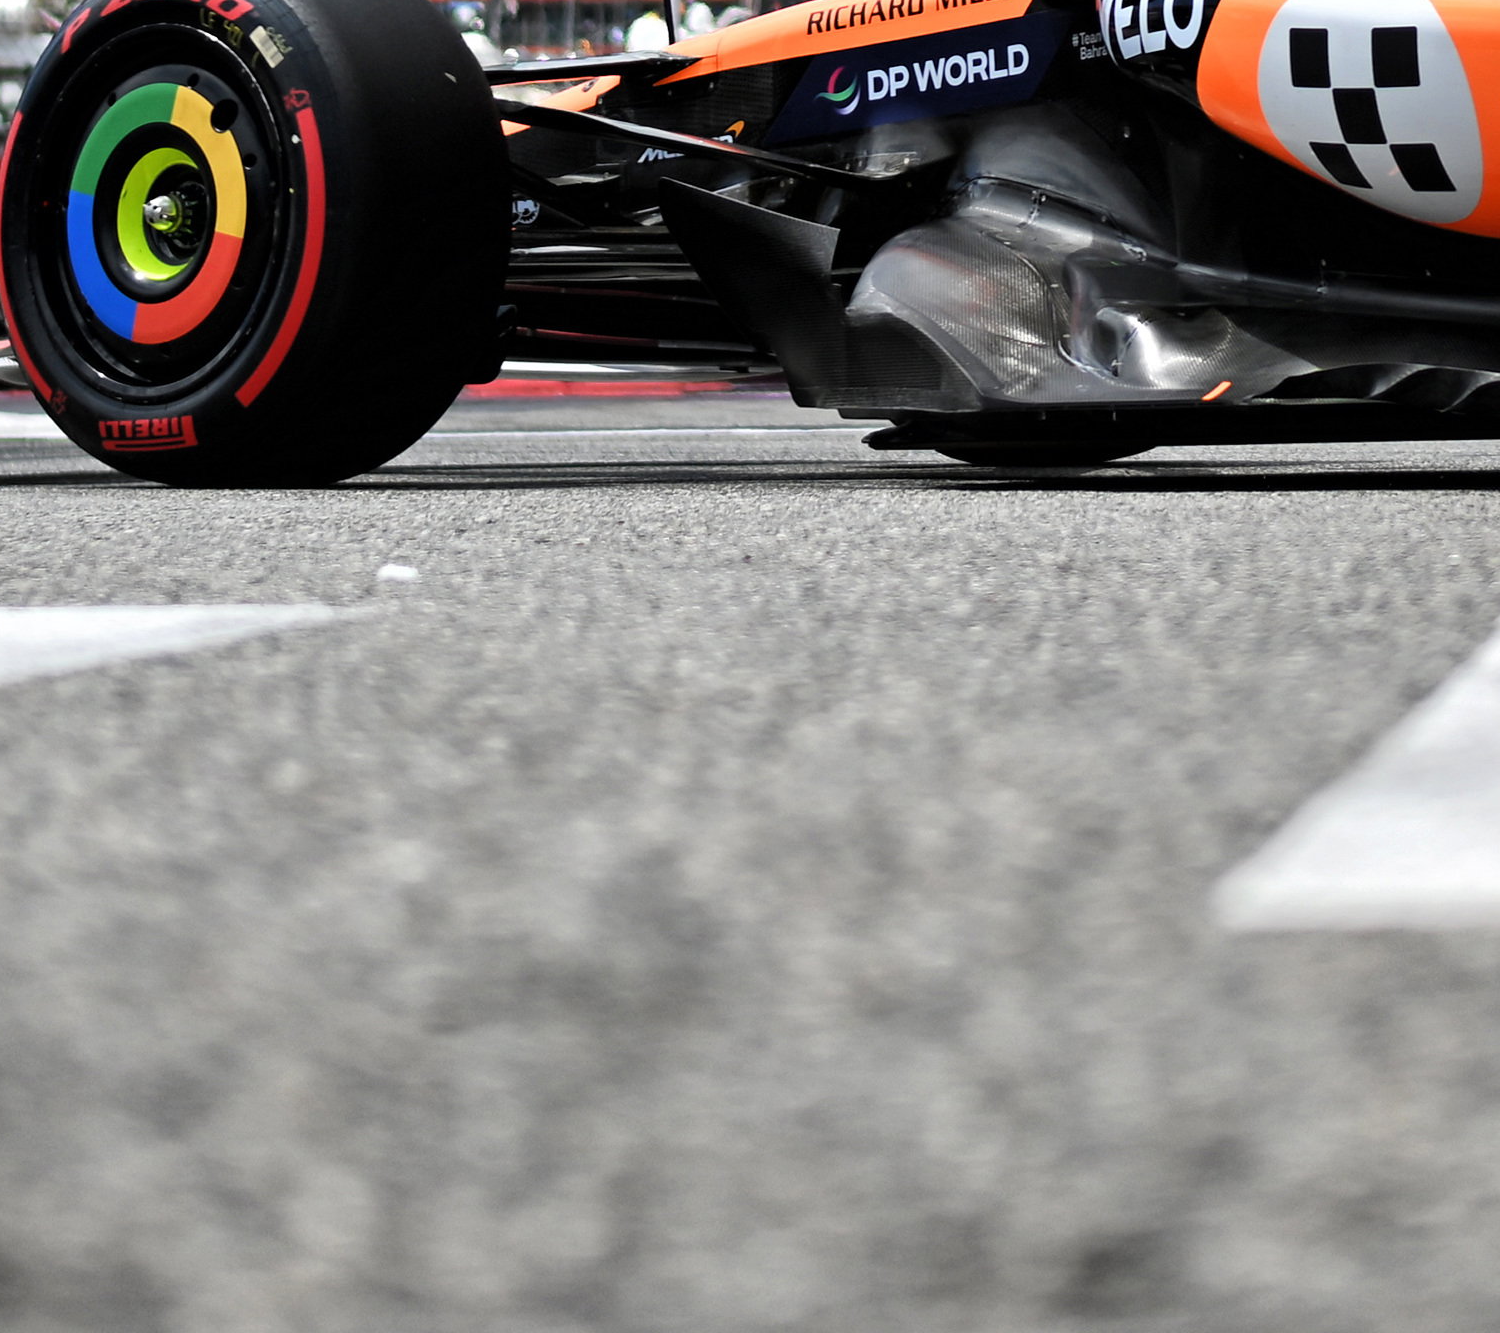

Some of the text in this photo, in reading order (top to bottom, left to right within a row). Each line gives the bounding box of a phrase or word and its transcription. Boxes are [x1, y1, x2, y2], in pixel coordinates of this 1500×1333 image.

[61, 7, 91, 54] P
[867, 44, 1029, 100] DP WORLD
[98, 415, 198, 452] PIRELLI
